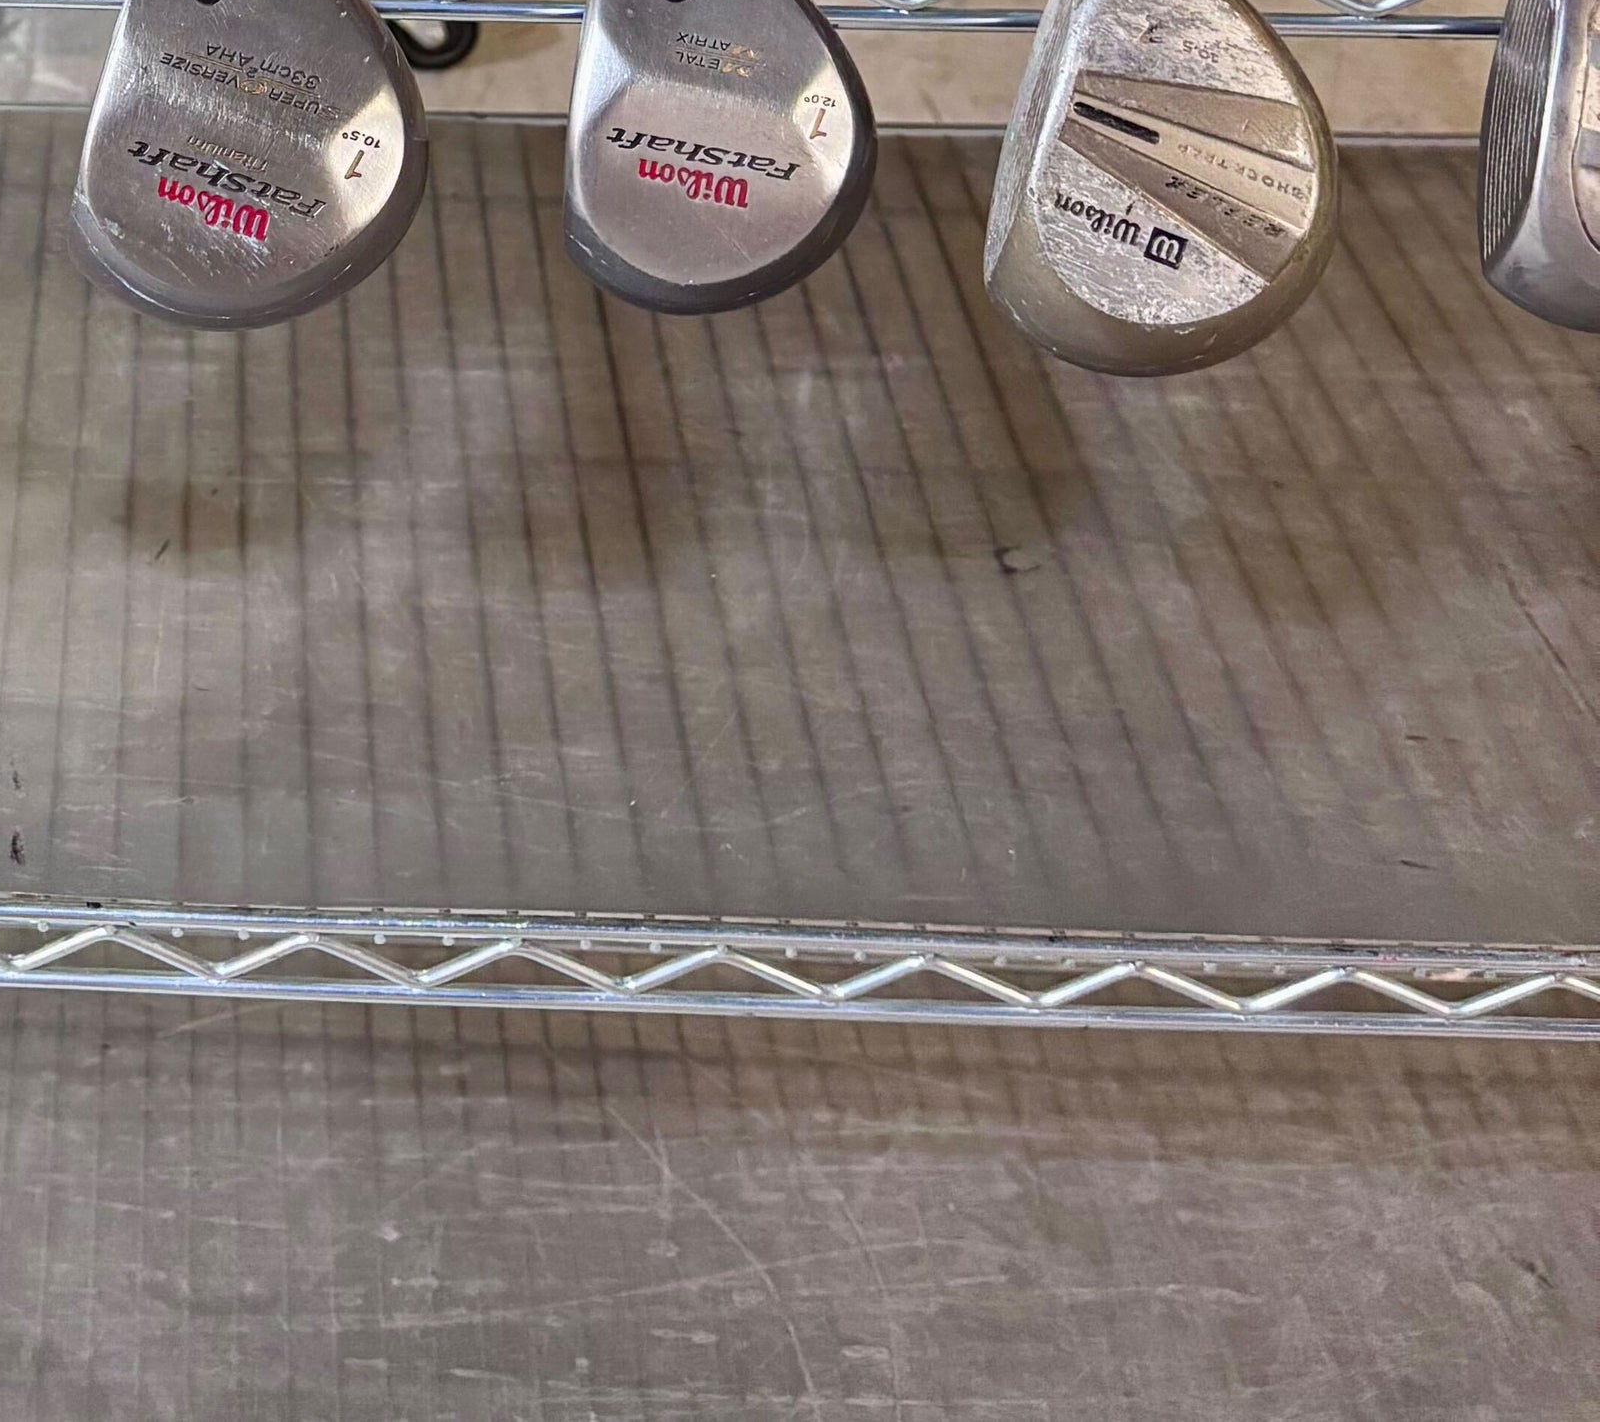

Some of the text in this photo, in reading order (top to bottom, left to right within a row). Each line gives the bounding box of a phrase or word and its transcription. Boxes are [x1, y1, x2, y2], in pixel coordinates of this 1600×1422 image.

[206, 41, 253, 67] AHA
[268, 87, 341, 121] SUPER
[809, 108, 828, 140] 1
[344, 150, 364, 180] 1
[605, 127, 802, 181] FatShaft
[128, 140, 327, 219] FatShaft
[638, 158, 750, 208] Wilson
[157, 176, 271, 243] Wilson
[1054, 192, 1141, 246] Wilson
